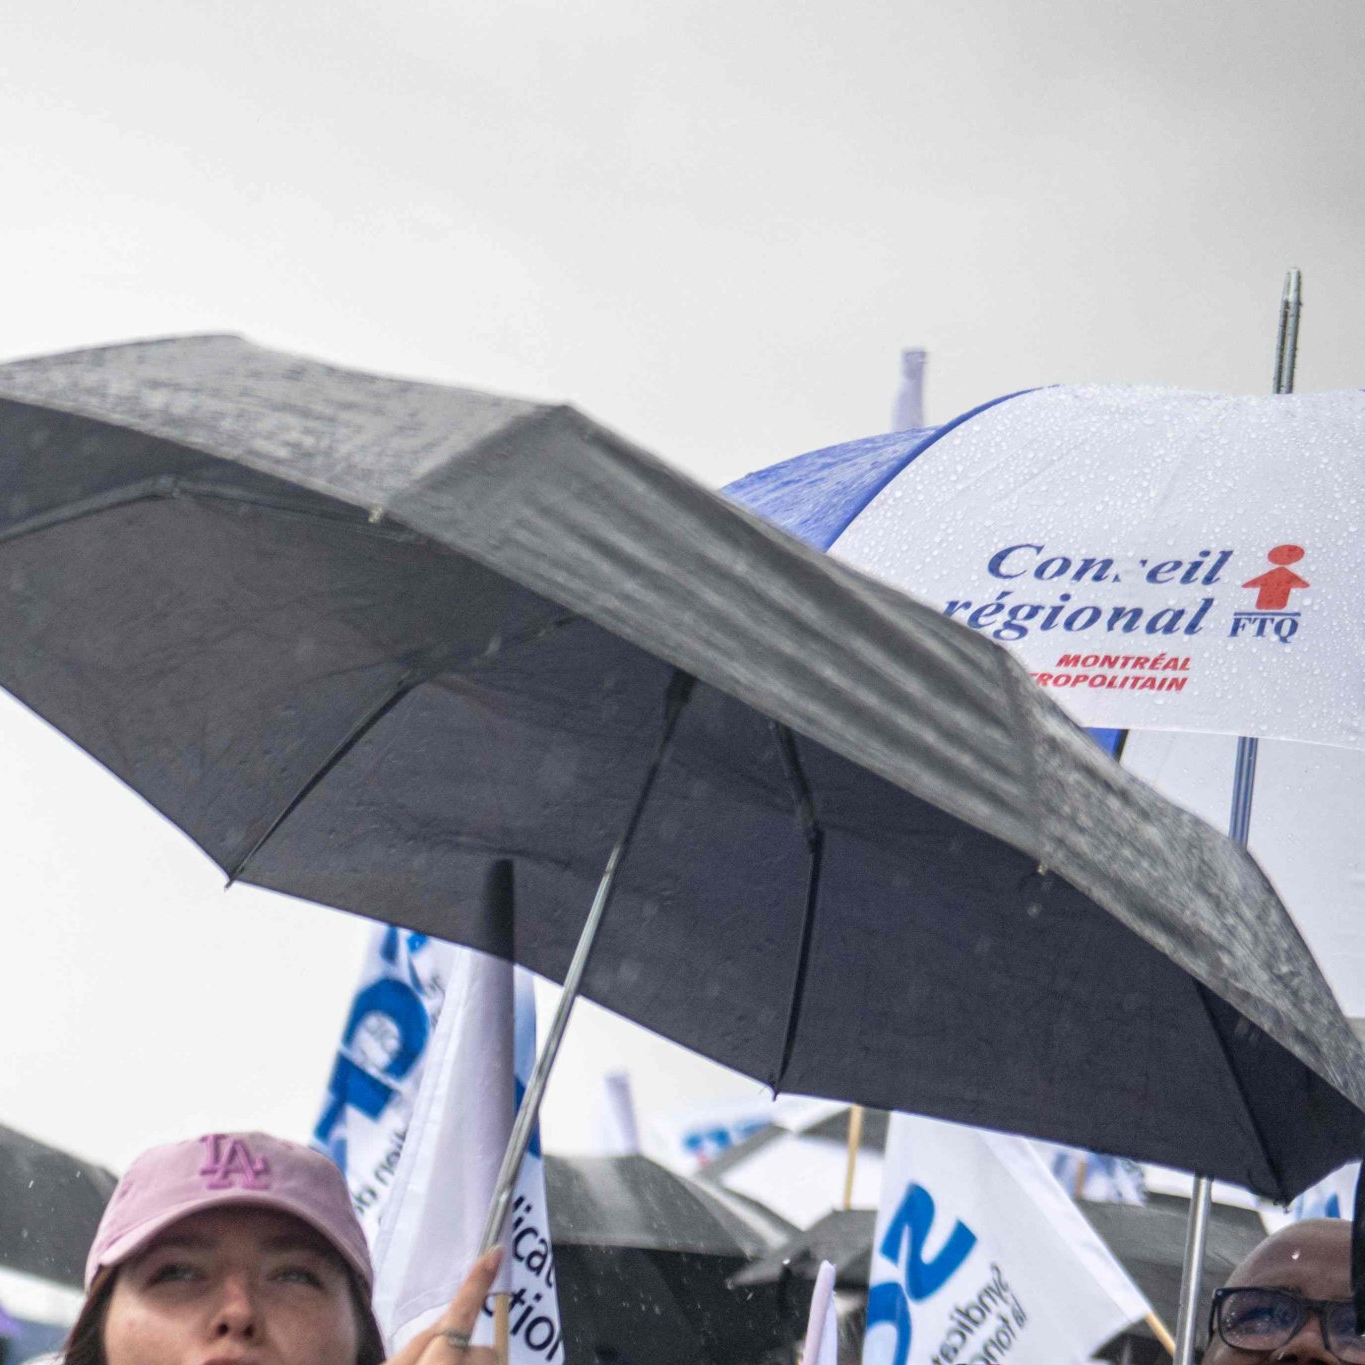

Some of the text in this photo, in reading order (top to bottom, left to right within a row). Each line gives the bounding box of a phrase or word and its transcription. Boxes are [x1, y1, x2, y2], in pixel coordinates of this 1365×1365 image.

[987, 543, 1234, 586] Coneil
[943, 590, 1215, 641] régional
[1227, 616, 1301, 644] FTQ
[1055, 651, 1192, 672] MONTRÉAL
[199, 1133, 270, 1190] LA
